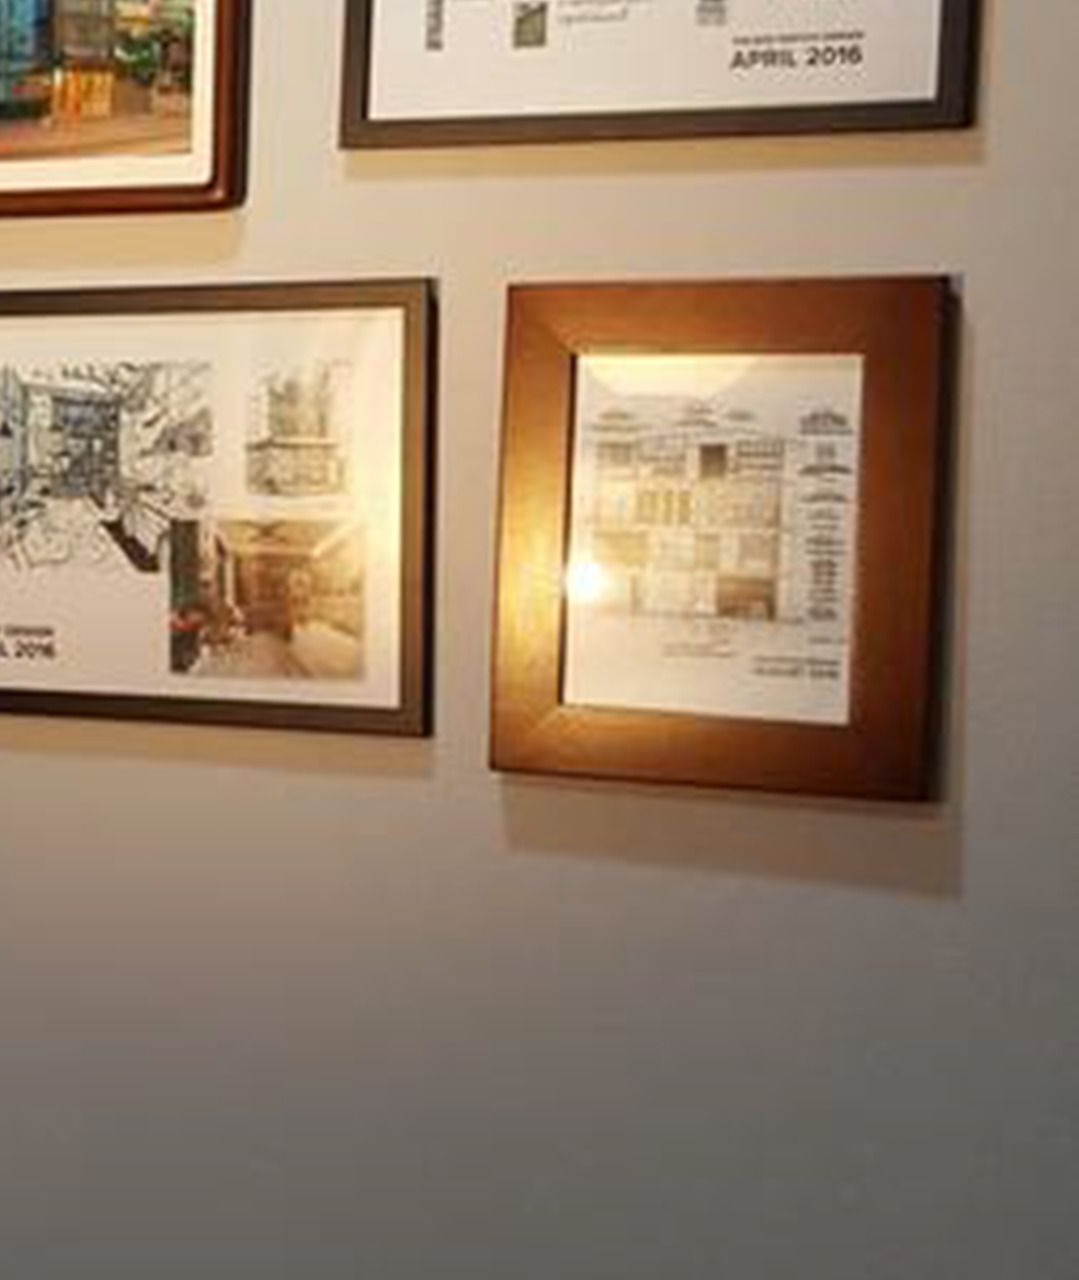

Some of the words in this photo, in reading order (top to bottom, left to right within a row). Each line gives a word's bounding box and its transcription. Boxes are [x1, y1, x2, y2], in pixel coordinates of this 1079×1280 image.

[729, 49, 797, 69] APRIL
[806, 45, 863, 65] 2016
[15, 640, 56, 659] 2016
